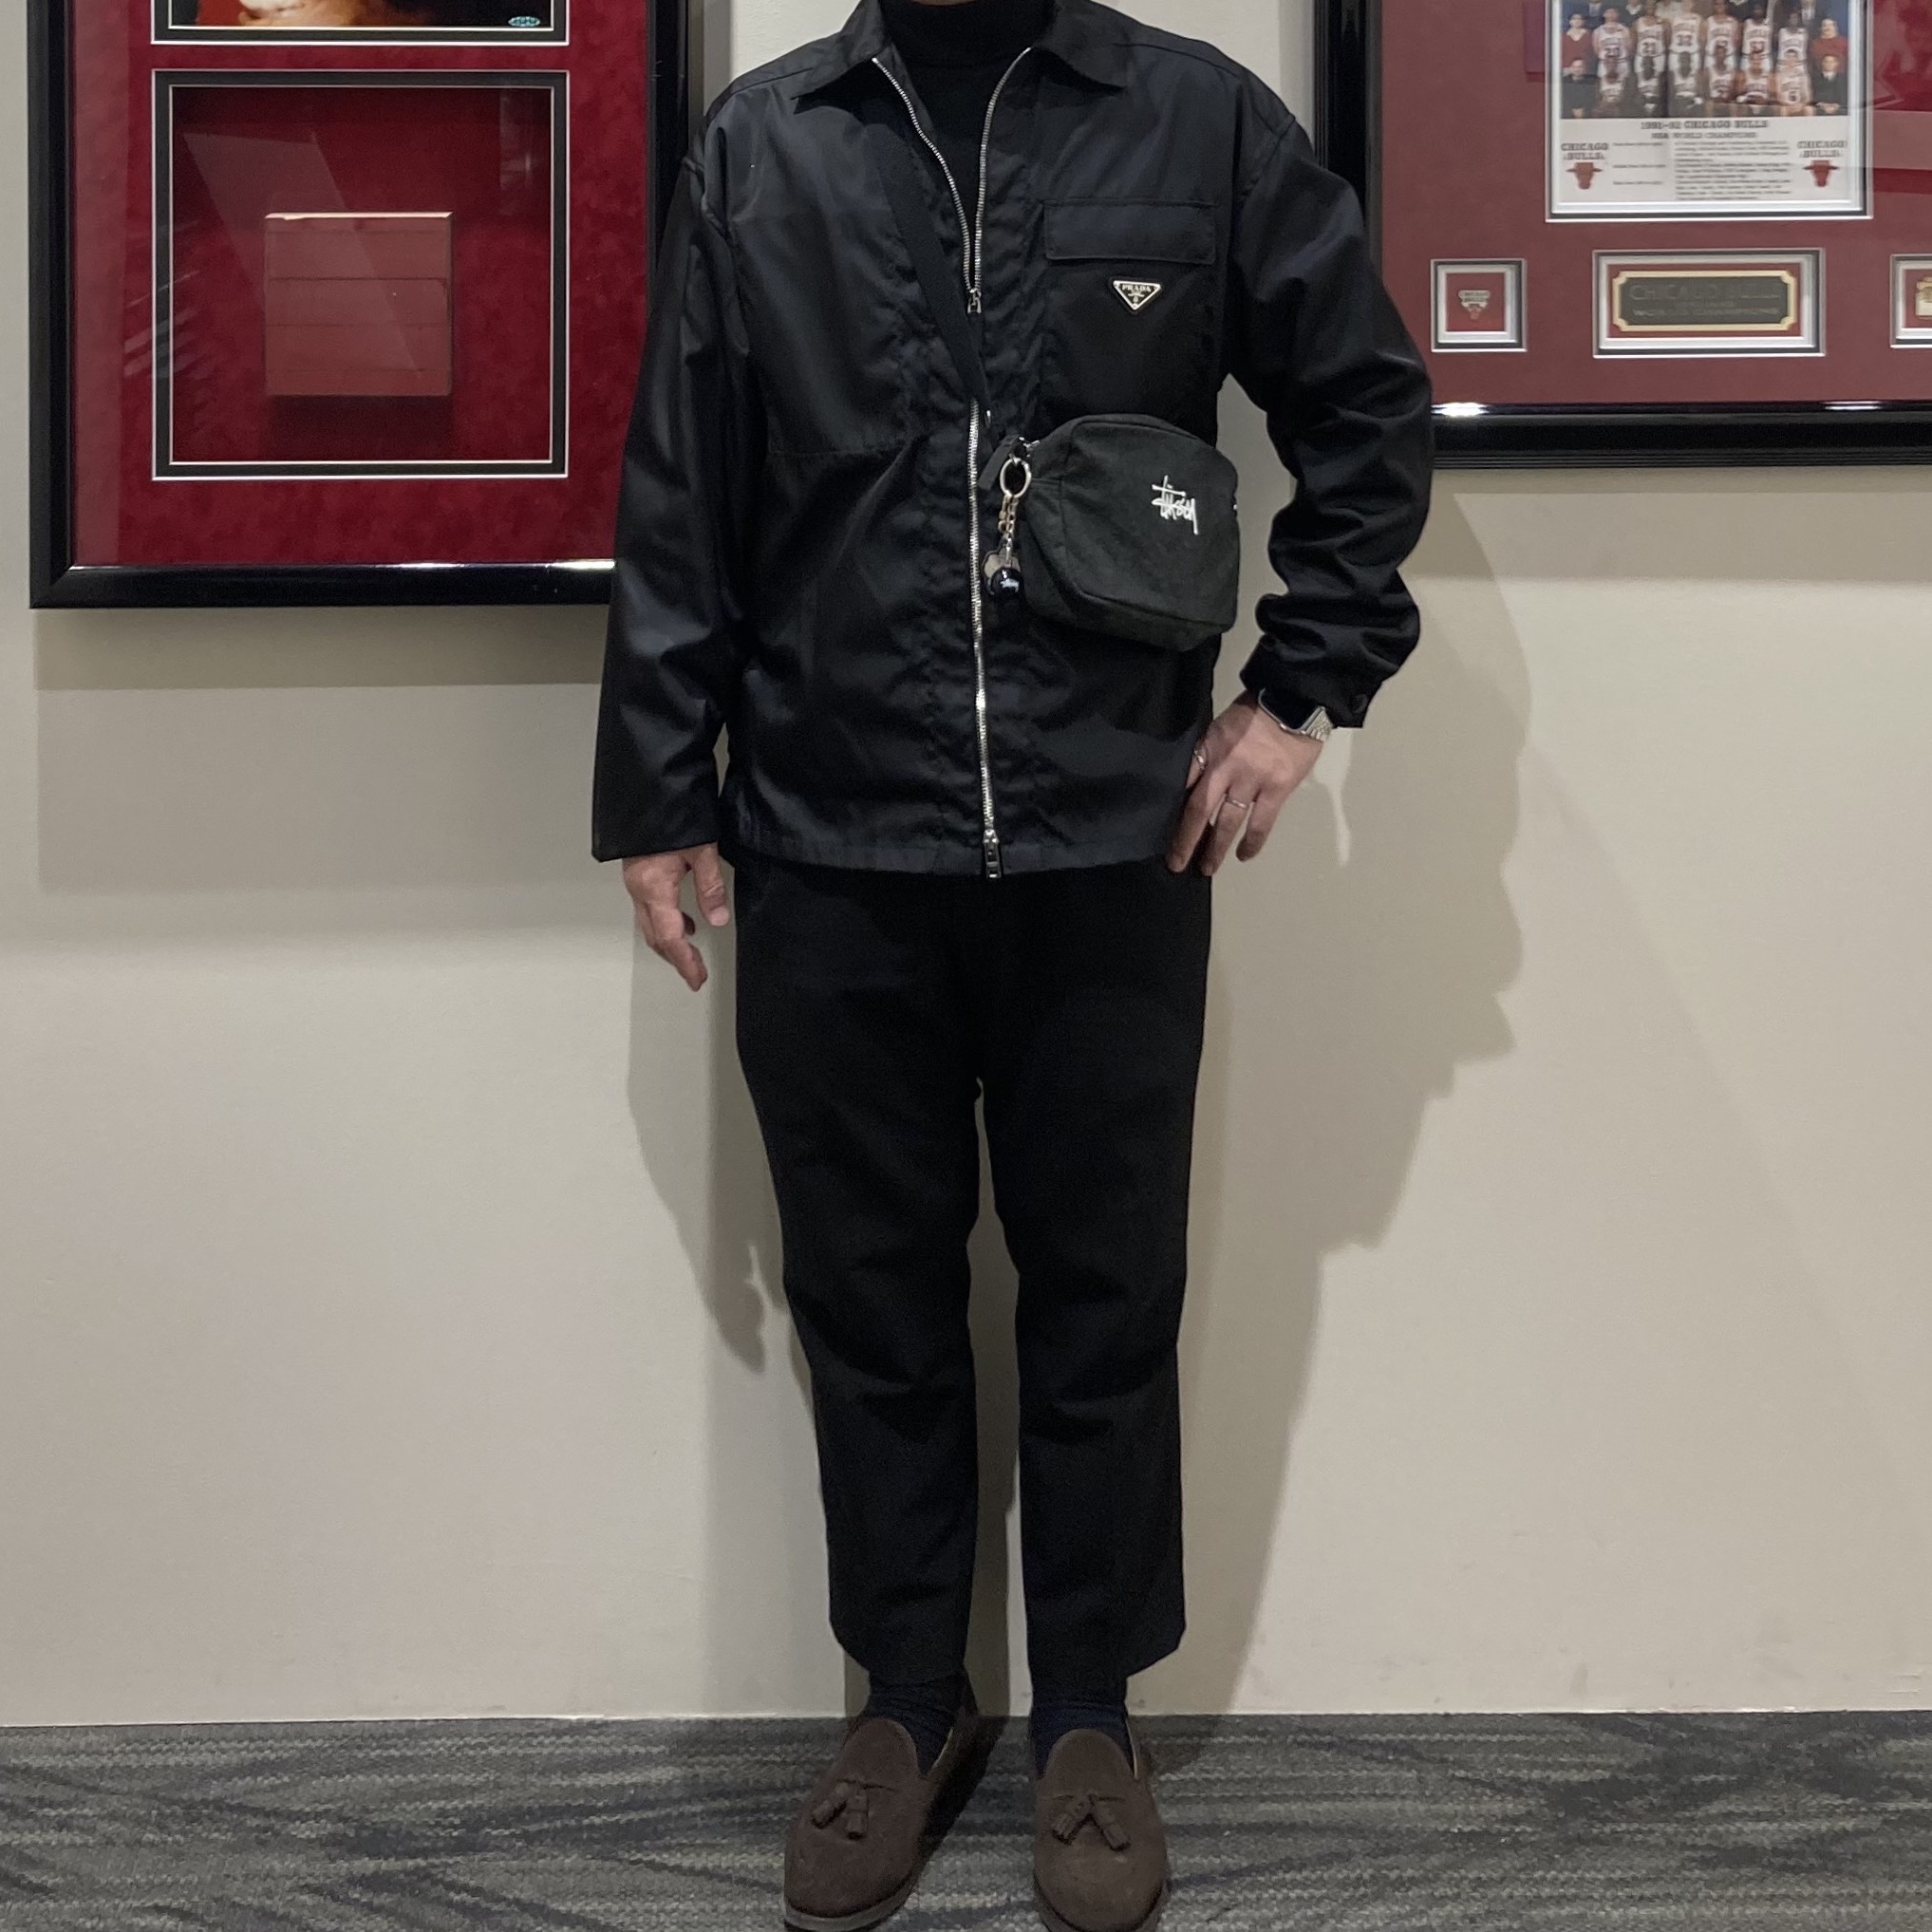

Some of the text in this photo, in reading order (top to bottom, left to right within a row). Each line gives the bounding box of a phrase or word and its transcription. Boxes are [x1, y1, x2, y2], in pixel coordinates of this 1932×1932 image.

[1683, 121, 1731, 129] CHICAGO
[1560, 142, 1609, 151] CHICAGO
[1796, 141, 1848, 149] CHICAGO
[1563, 152, 1605, 160] BULLS
[1121, 284, 1152, 292] PRADA
